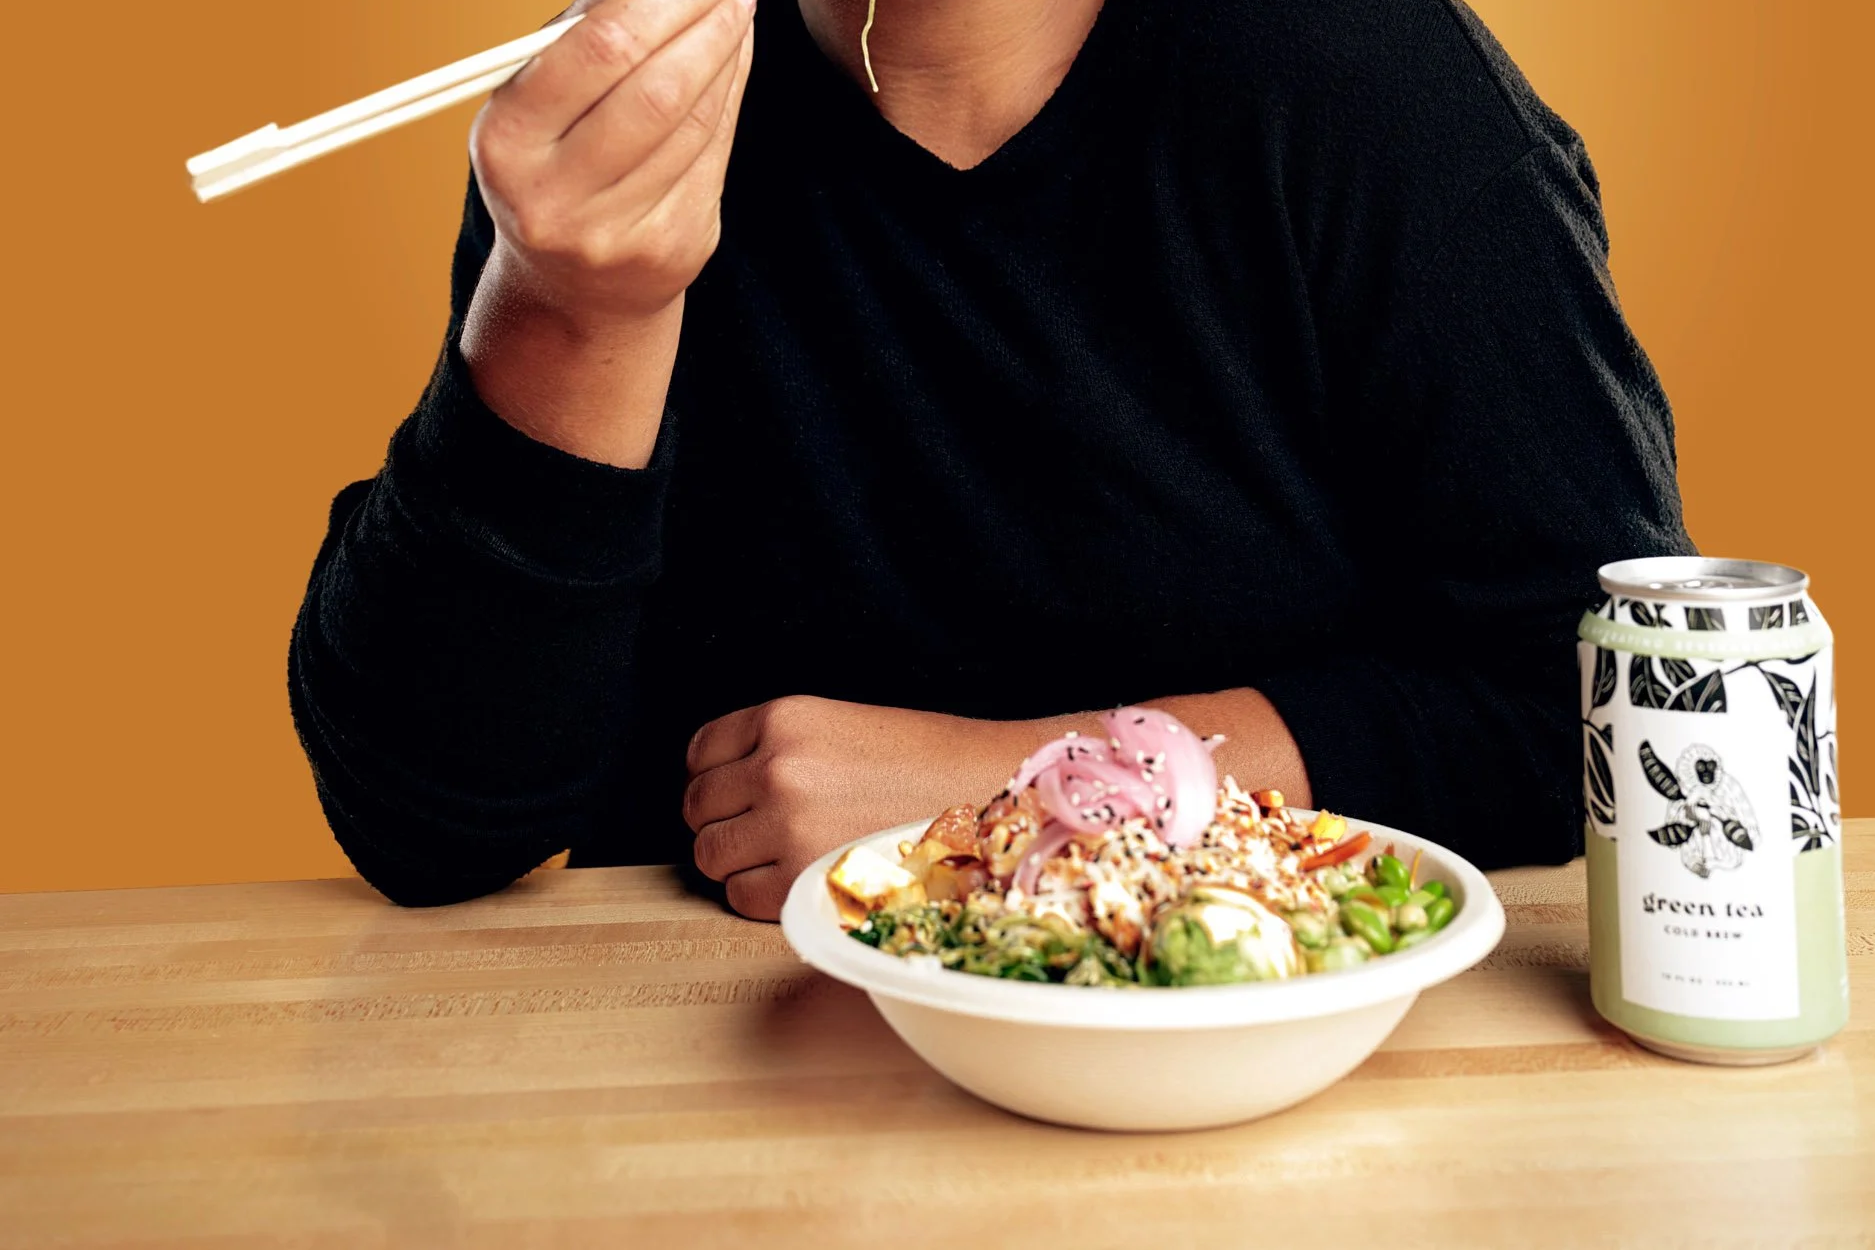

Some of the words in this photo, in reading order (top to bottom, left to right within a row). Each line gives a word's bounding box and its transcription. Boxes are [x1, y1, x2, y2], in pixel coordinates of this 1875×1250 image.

[1642, 892, 1716, 917] green
[1725, 902, 1765, 918] tea
[1663, 924, 1699, 939] COLD
[1706, 929, 1743, 940] BREW
